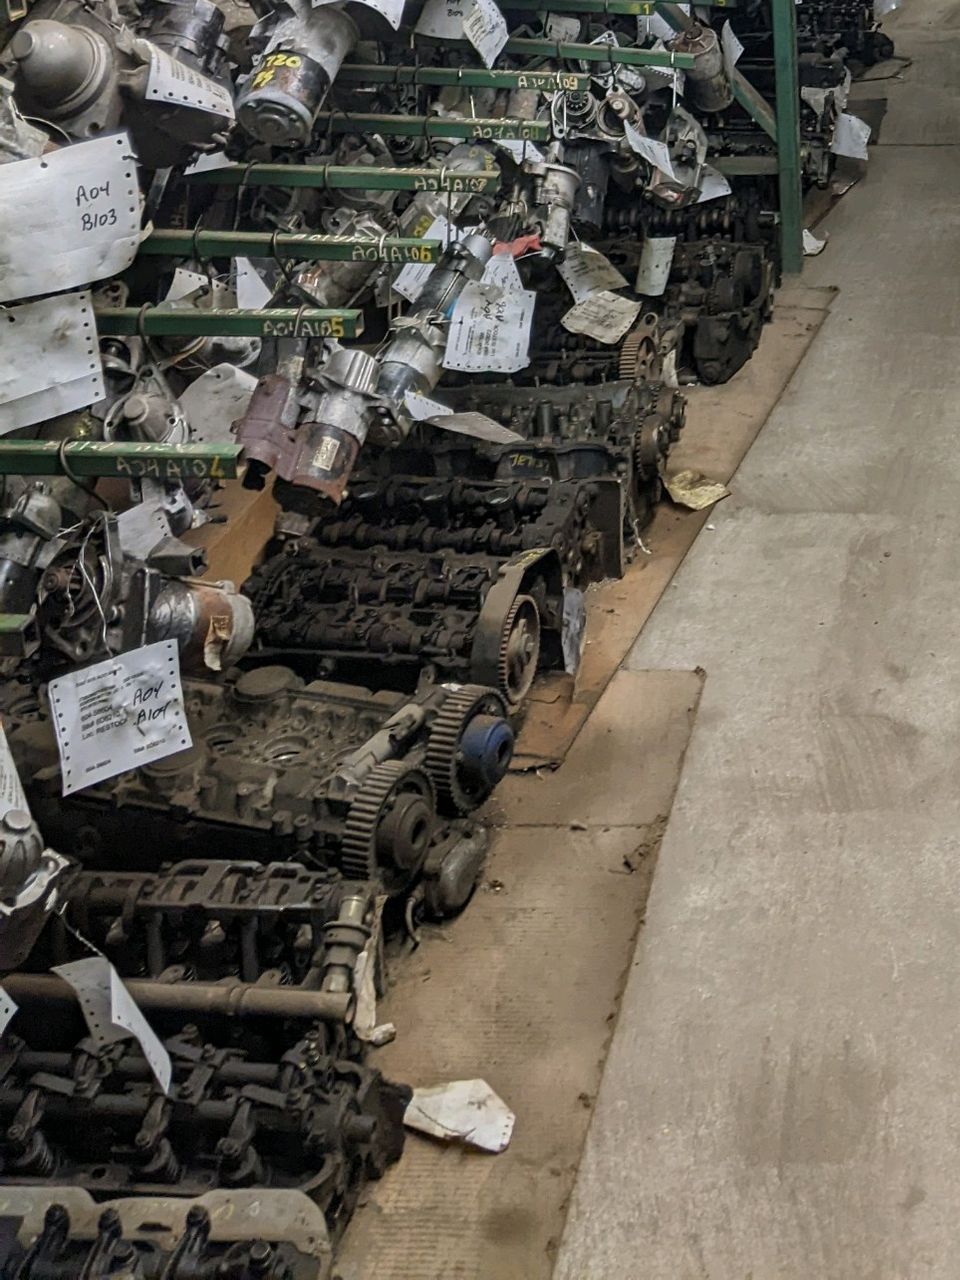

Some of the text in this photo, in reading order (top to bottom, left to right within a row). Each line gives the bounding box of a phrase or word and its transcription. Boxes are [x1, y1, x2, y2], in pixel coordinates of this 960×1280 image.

[75, 180, 111, 207] A04
[81, 207, 118, 232] B103
[133, 679, 165, 707] A04
